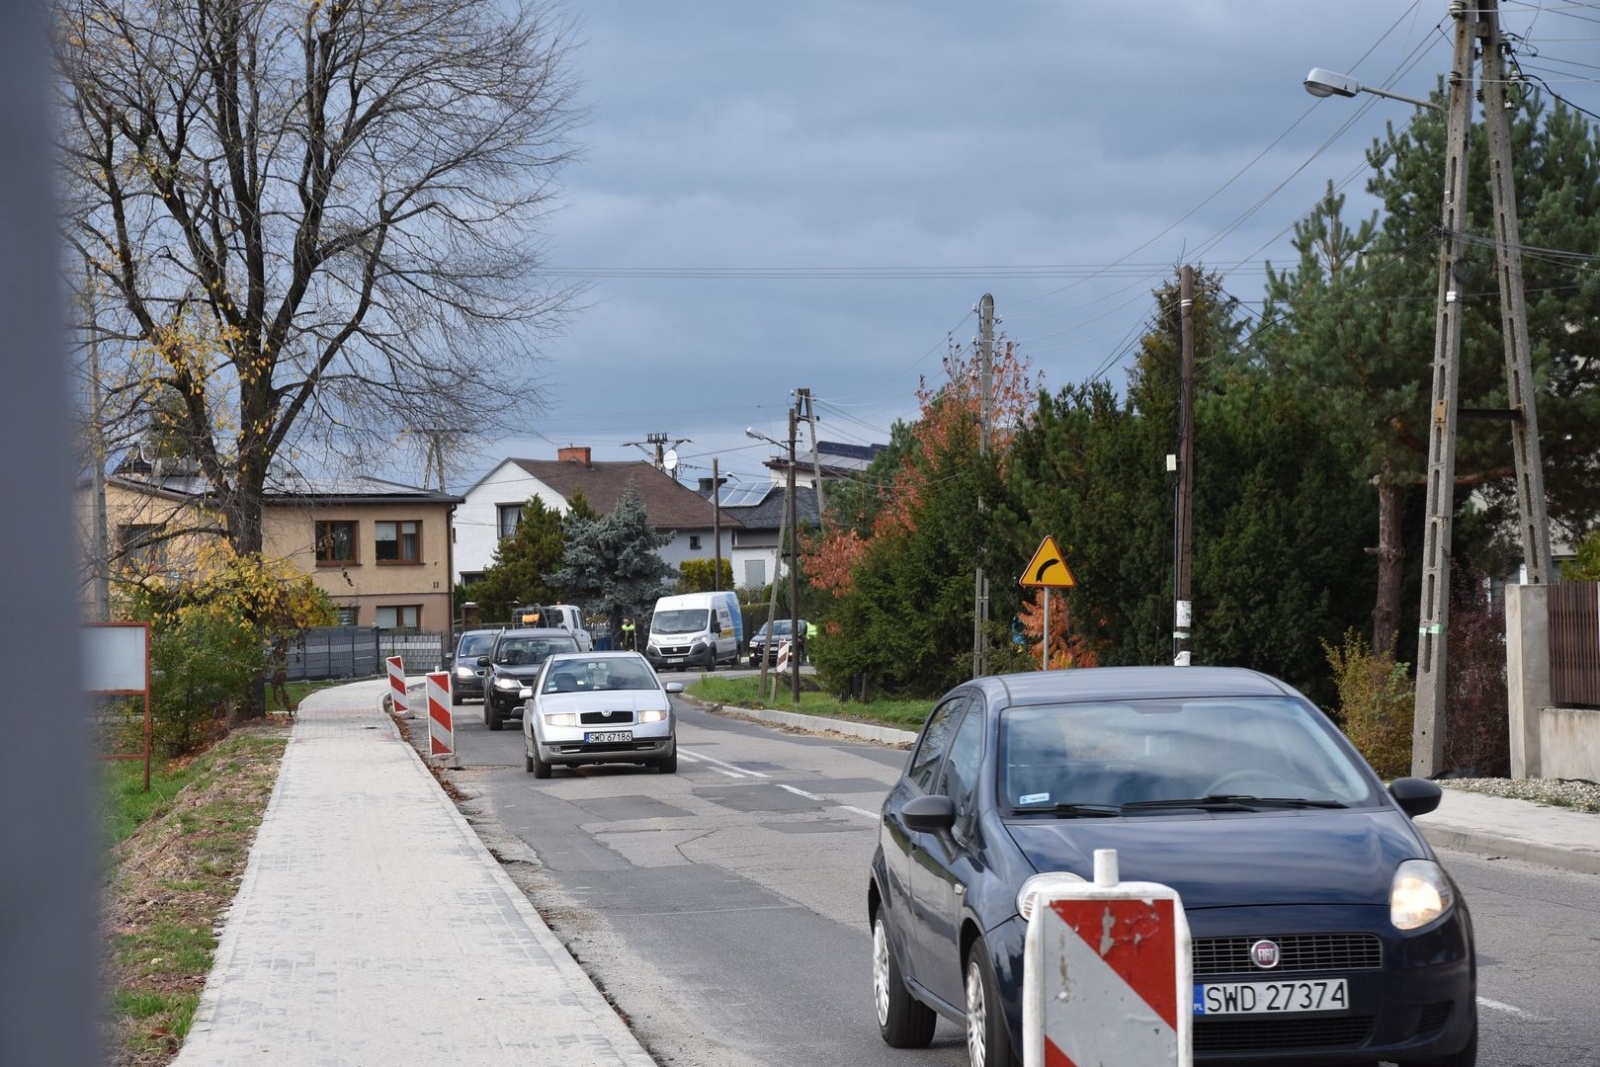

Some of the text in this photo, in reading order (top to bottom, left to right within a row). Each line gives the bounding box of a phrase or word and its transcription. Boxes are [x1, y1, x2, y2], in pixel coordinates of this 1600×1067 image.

[590, 732, 631, 743] SWD 67186
[1257, 948, 1274, 961] FIAT
[1206, 981, 1345, 1012] SWD 27374
[1193, 1003, 1204, 1011] PL
